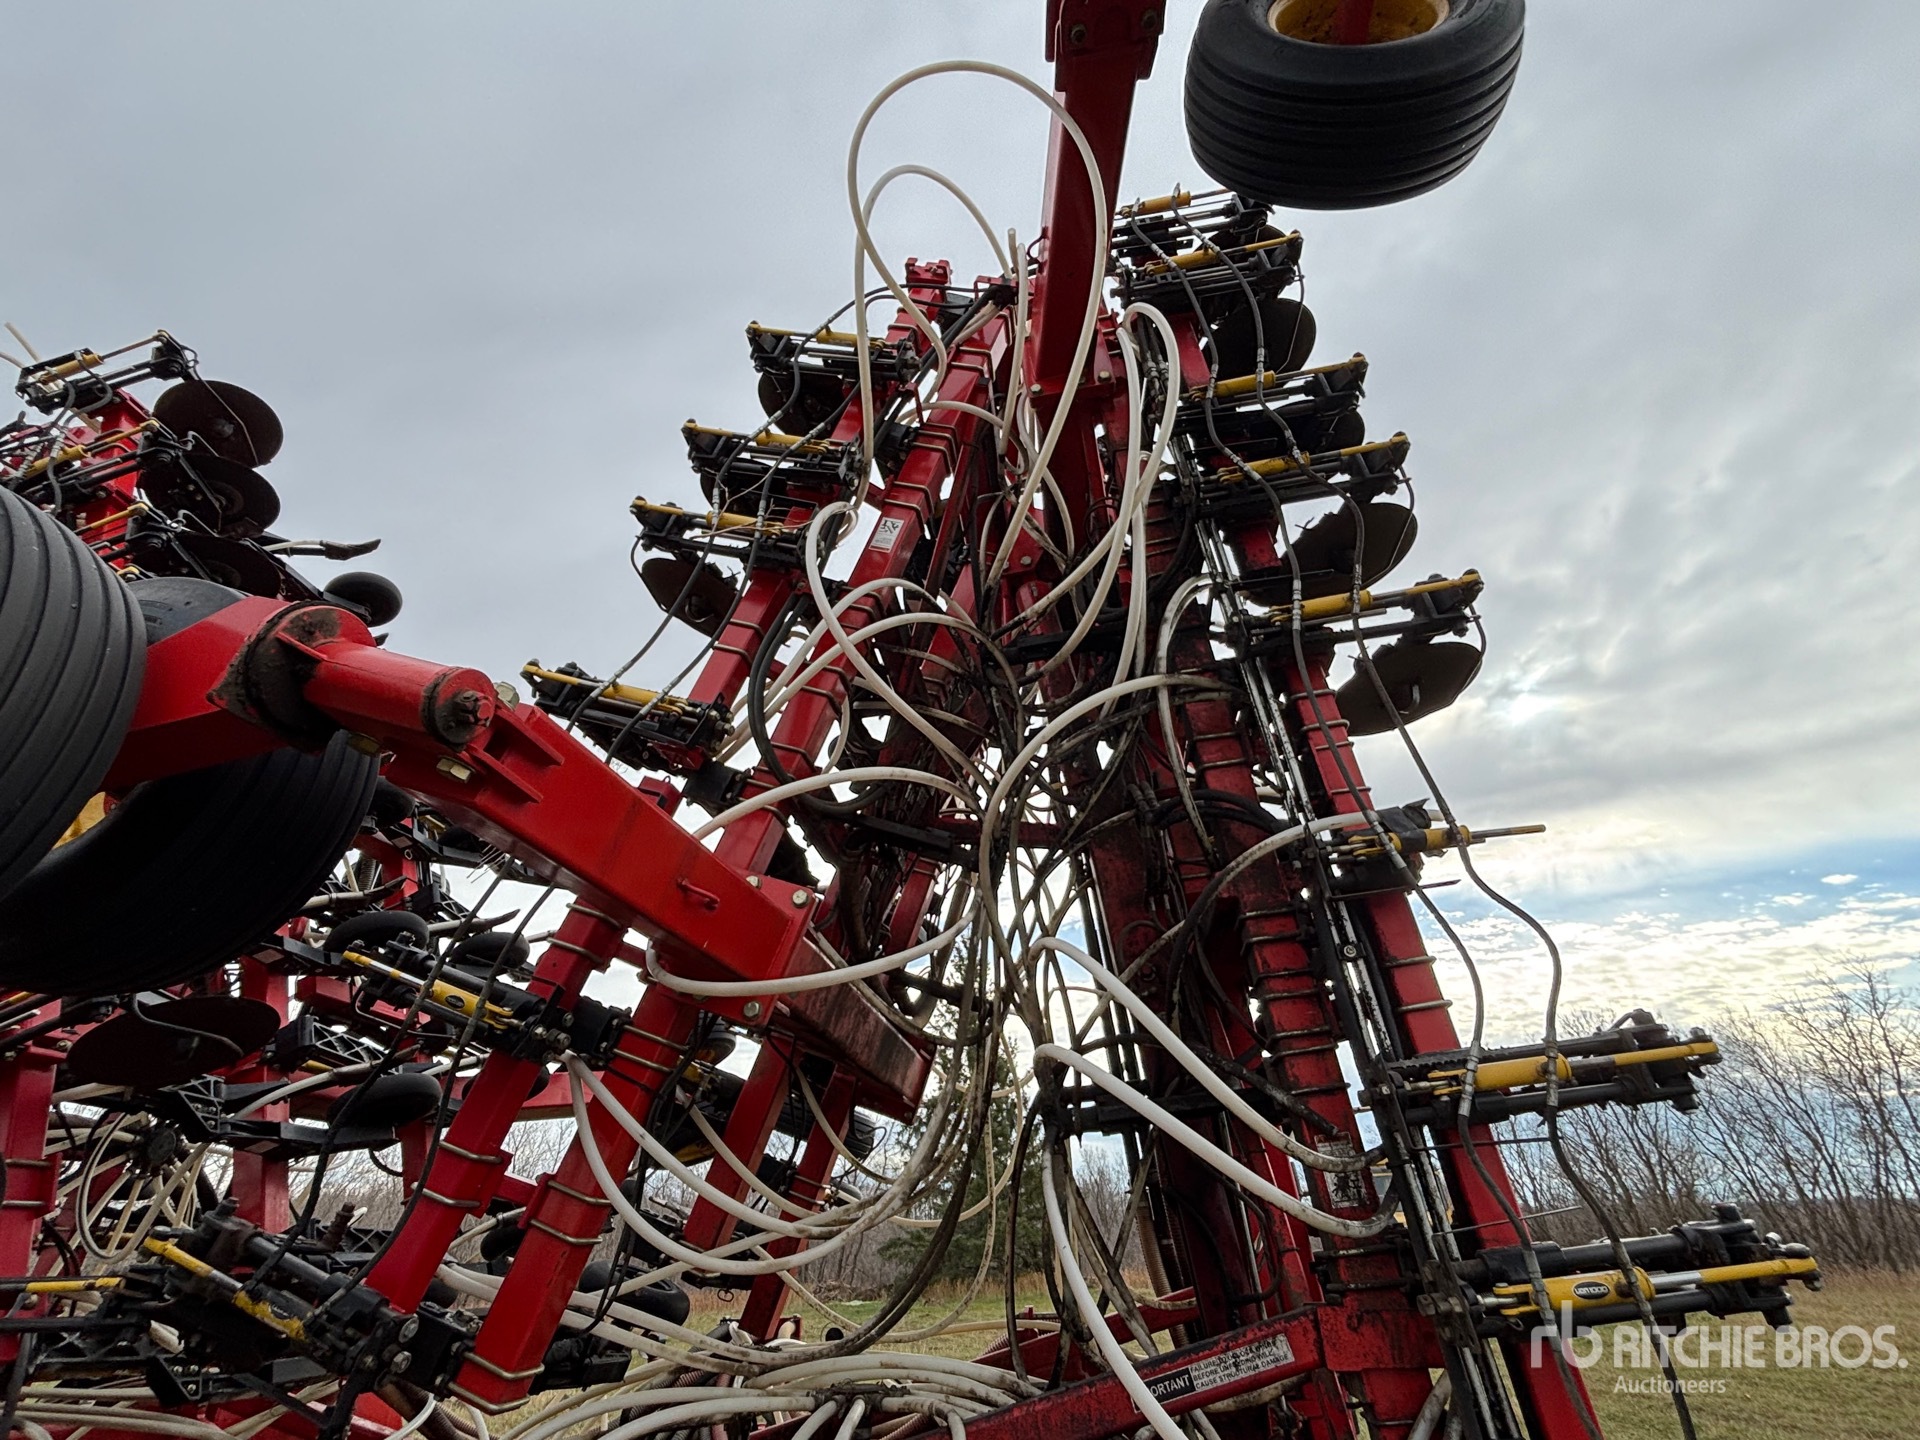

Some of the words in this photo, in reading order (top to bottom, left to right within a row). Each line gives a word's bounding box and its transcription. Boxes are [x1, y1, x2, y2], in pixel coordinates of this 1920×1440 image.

[1190, 1359, 1216, 1373] FAILURE
[1192, 1367, 1219, 1381] BEFORE
[1195, 1376, 1218, 1389] CAUSE
[1260, 1353, 1288, 1367] DAMAGE
[1150, 1374, 1190, 1397] ORTANT
